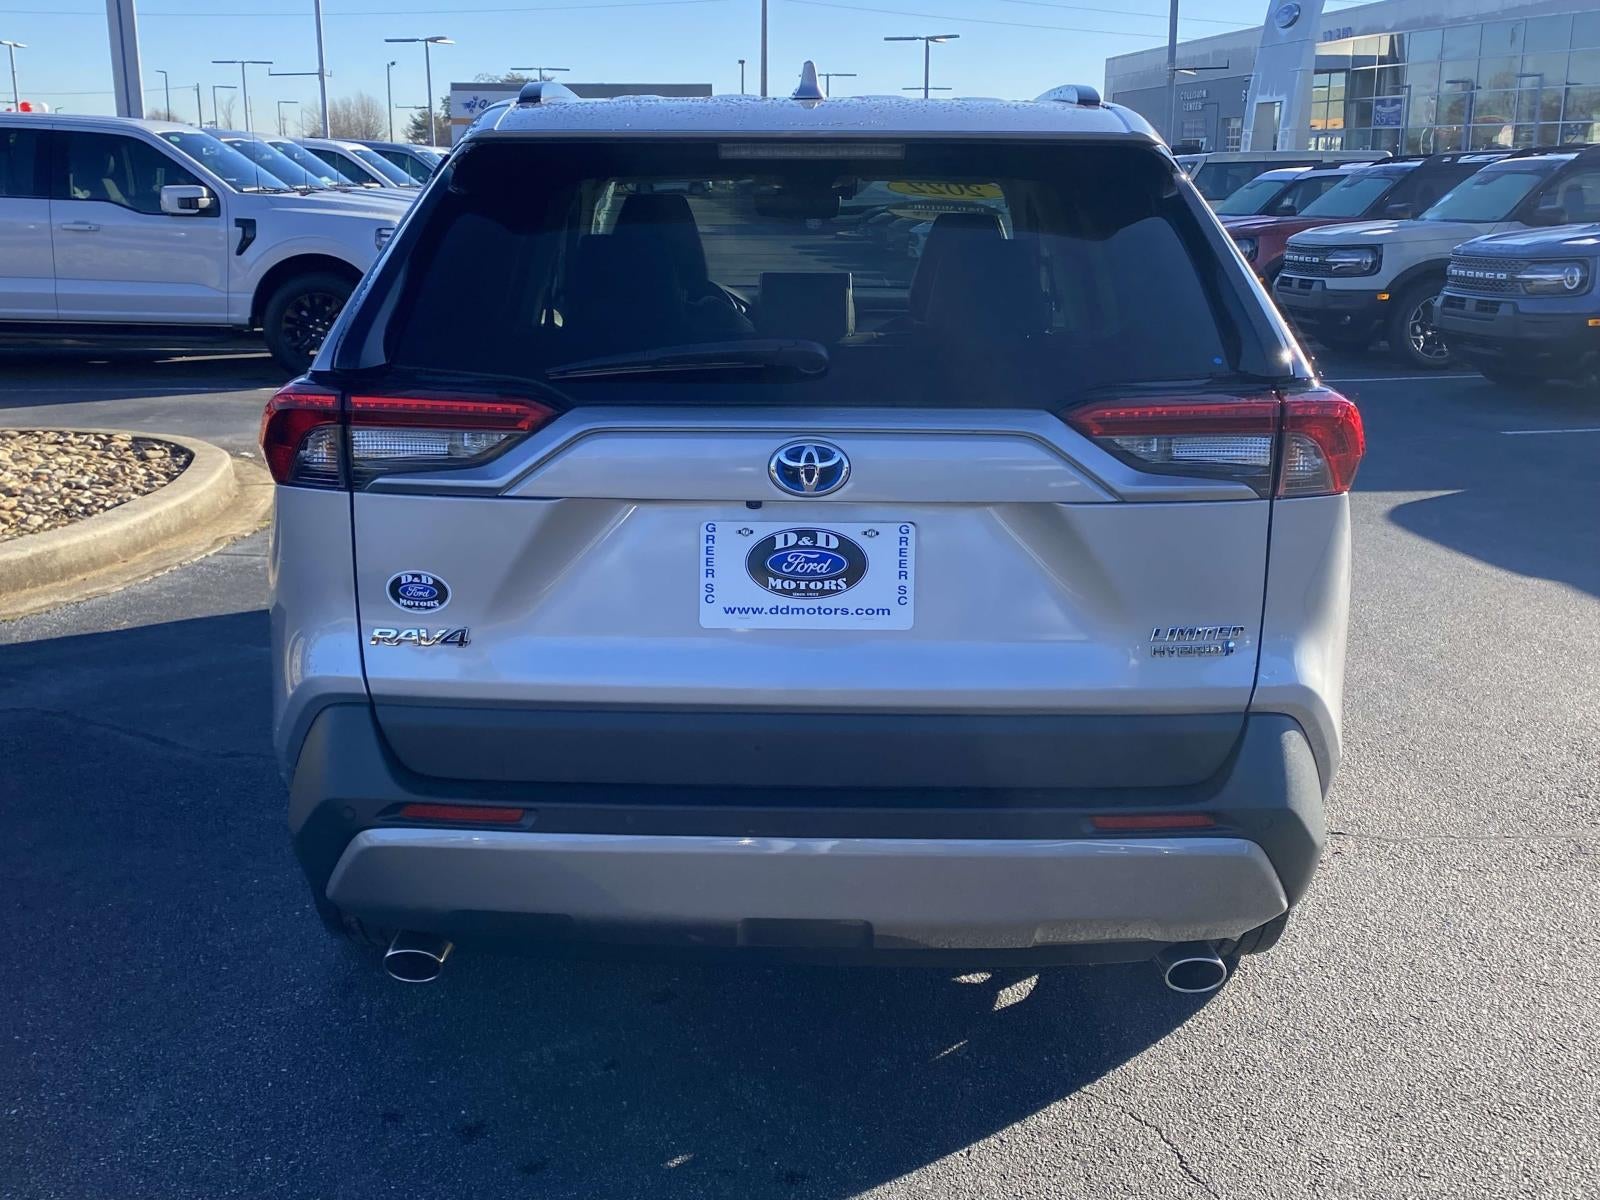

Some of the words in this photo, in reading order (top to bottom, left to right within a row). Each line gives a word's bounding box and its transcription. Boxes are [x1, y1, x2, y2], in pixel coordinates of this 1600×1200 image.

[1451, 269, 1507, 280] BRONCO
[774, 531, 839, 550] D&D
[705, 522, 717, 579] GREER
[898, 524, 910, 581] GREER
[782, 552, 832, 573] Ford
[400, 574, 434, 585] D&D
[767, 576, 847, 590] MOTORS
[406, 586, 430, 597] Ford
[704, 583, 716, 604] SC
[897, 585, 908, 606] SC
[400, 598, 440, 607] MOTORS
[723, 605, 891, 616] www.ddmotors.com
[370, 627, 471, 648] RAV4
[1150, 626, 1245, 641] LIMITED
